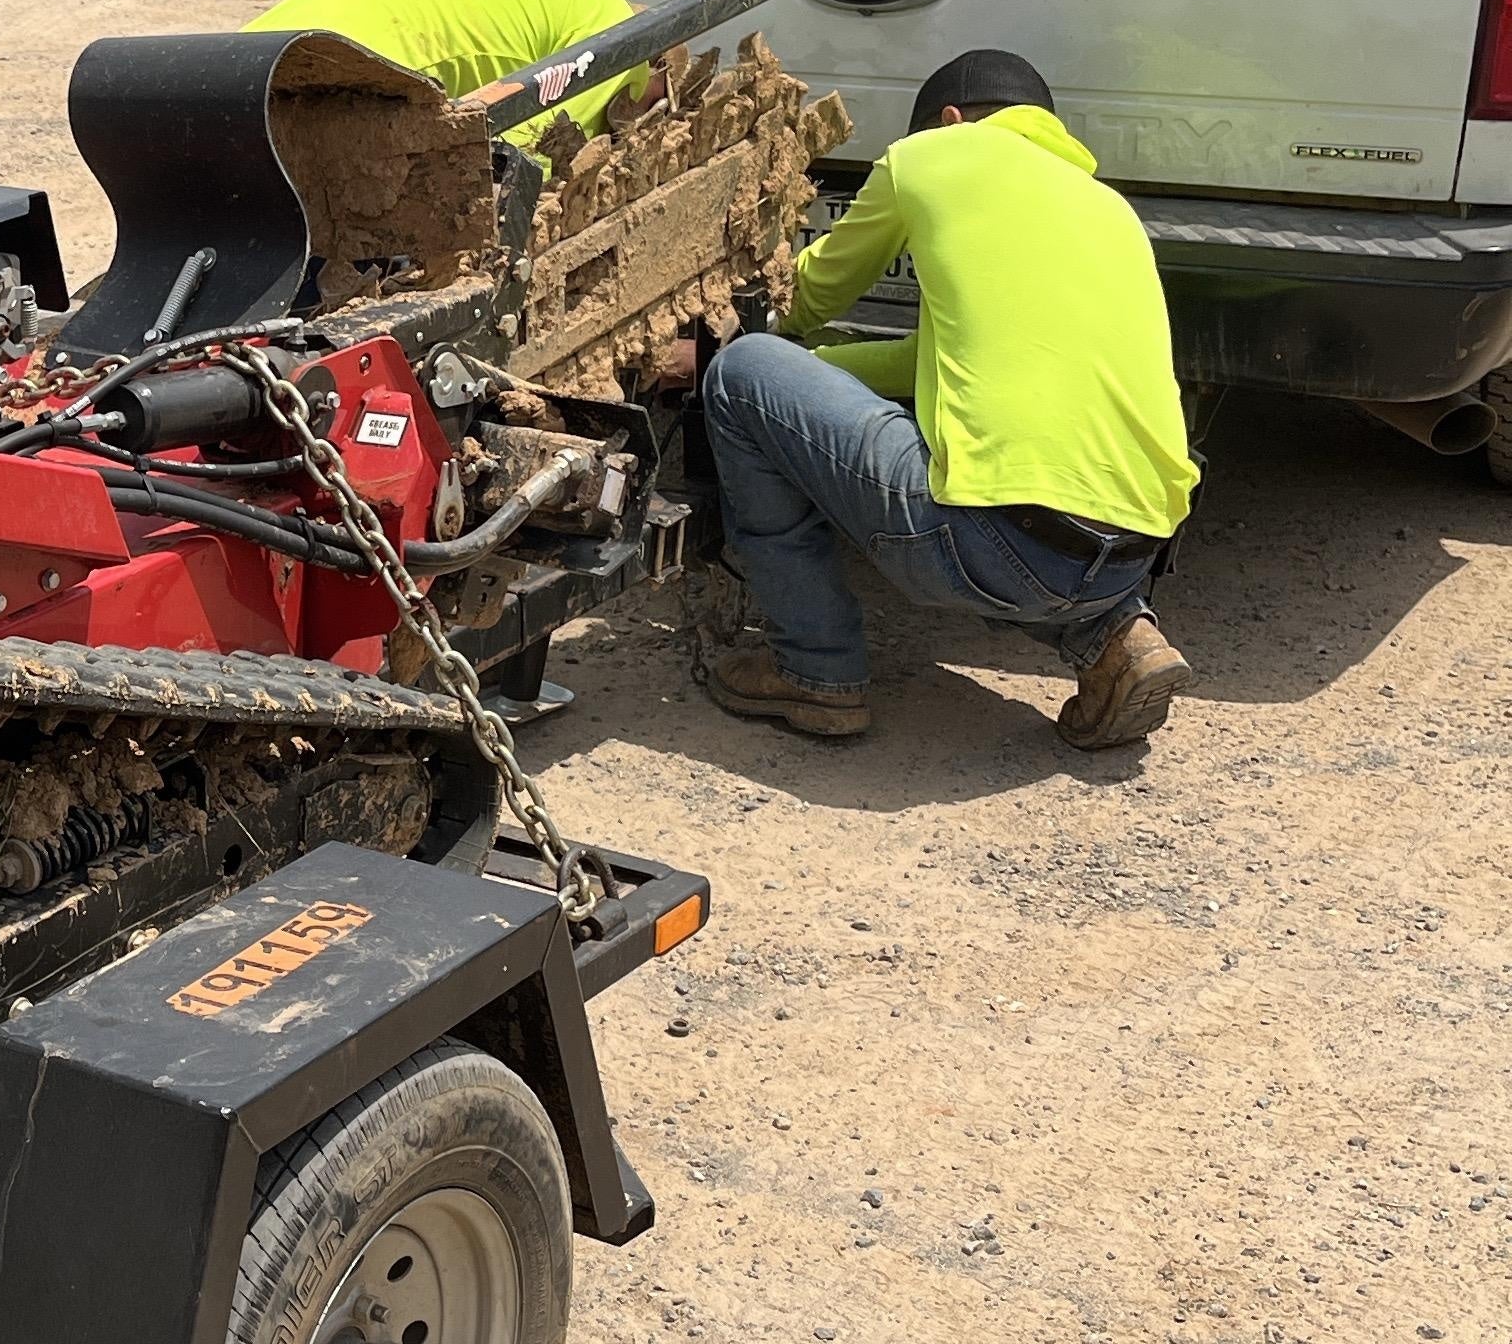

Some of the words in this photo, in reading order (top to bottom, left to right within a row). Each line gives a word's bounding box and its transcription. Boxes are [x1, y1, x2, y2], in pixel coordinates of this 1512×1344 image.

[1296, 145, 1347, 158] FLEX
[1364, 149, 1418, 163] FUEL
[178, 904, 369, 1008] 191159
